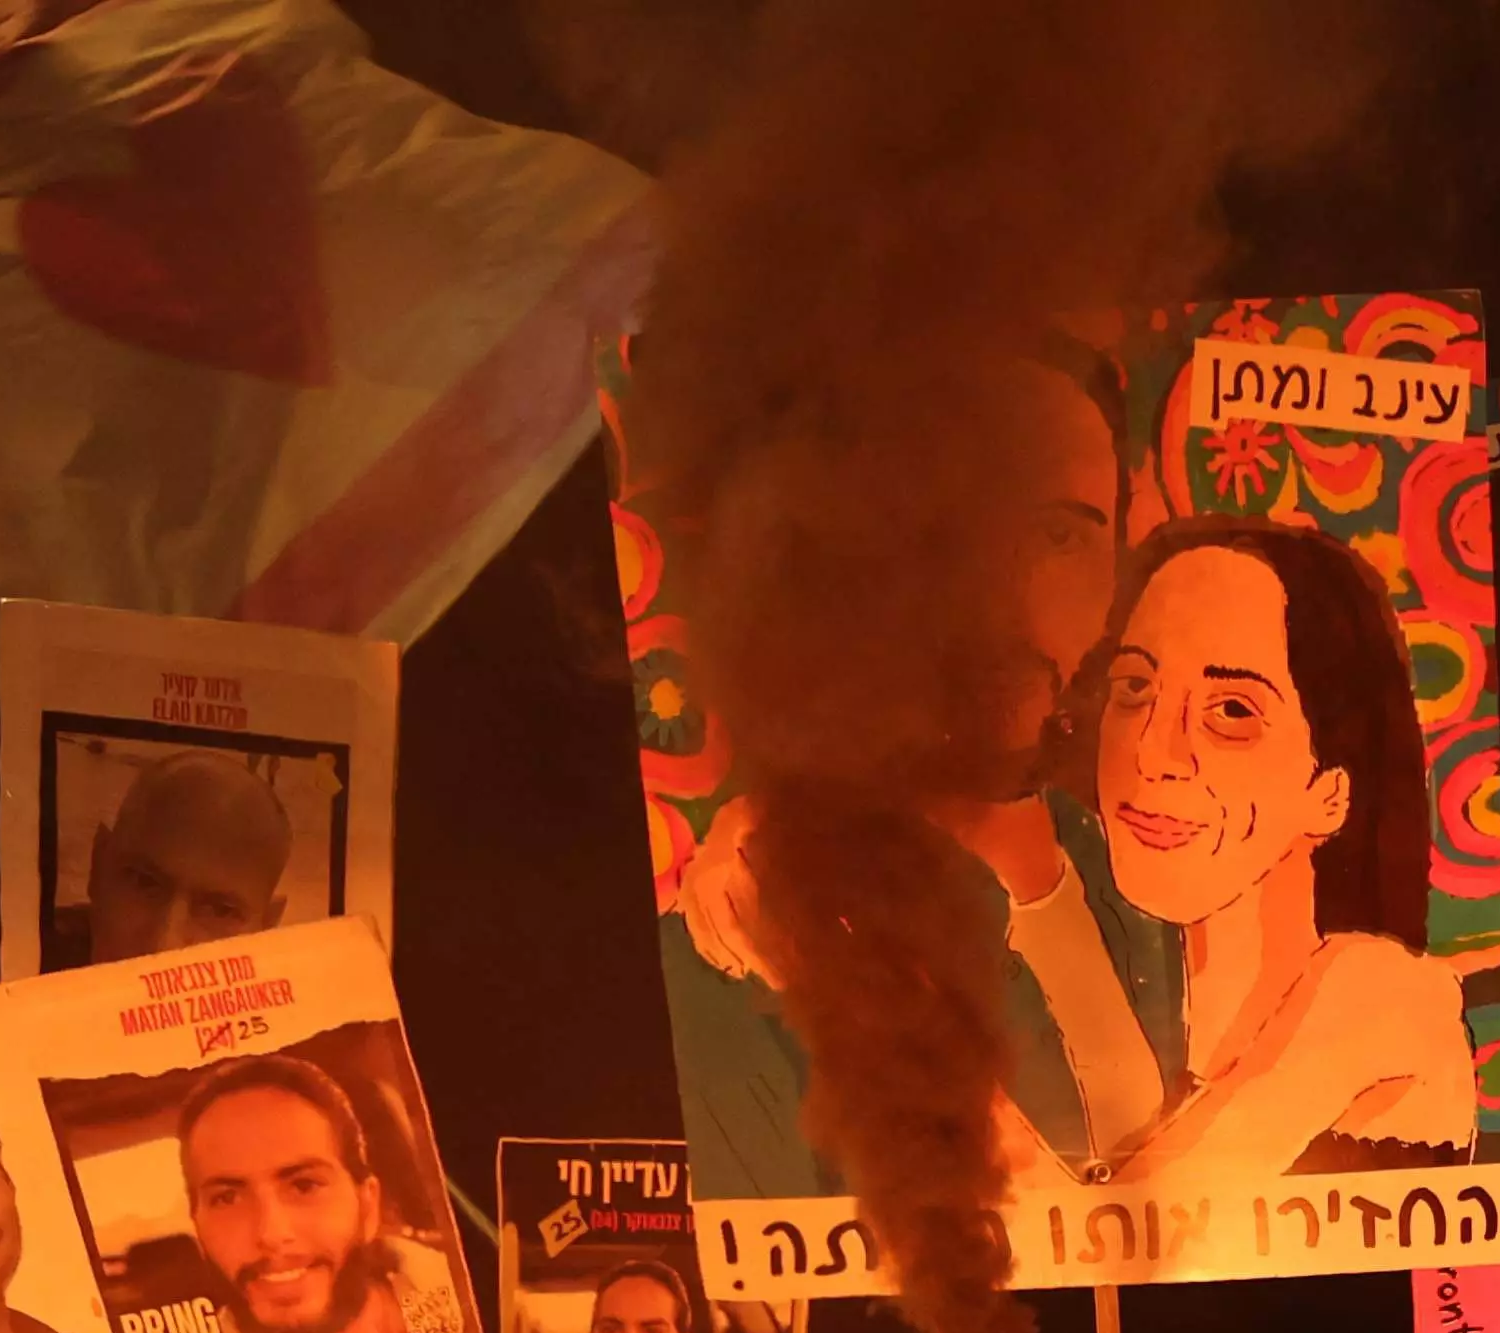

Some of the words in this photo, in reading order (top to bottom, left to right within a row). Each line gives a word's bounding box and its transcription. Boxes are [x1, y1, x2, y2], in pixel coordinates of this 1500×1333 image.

[1211, 358, 1327, 421] ומתן
[1353, 373, 1458, 424] עינב
[119, 1000, 185, 1037] MATAN
[184, 978, 295, 1024] ZANGAUKER
[557, 1159, 593, 1197] חי
[601, 1159, 678, 1204] עדיין
[1252, 1185, 1498, 1258] החזירו
